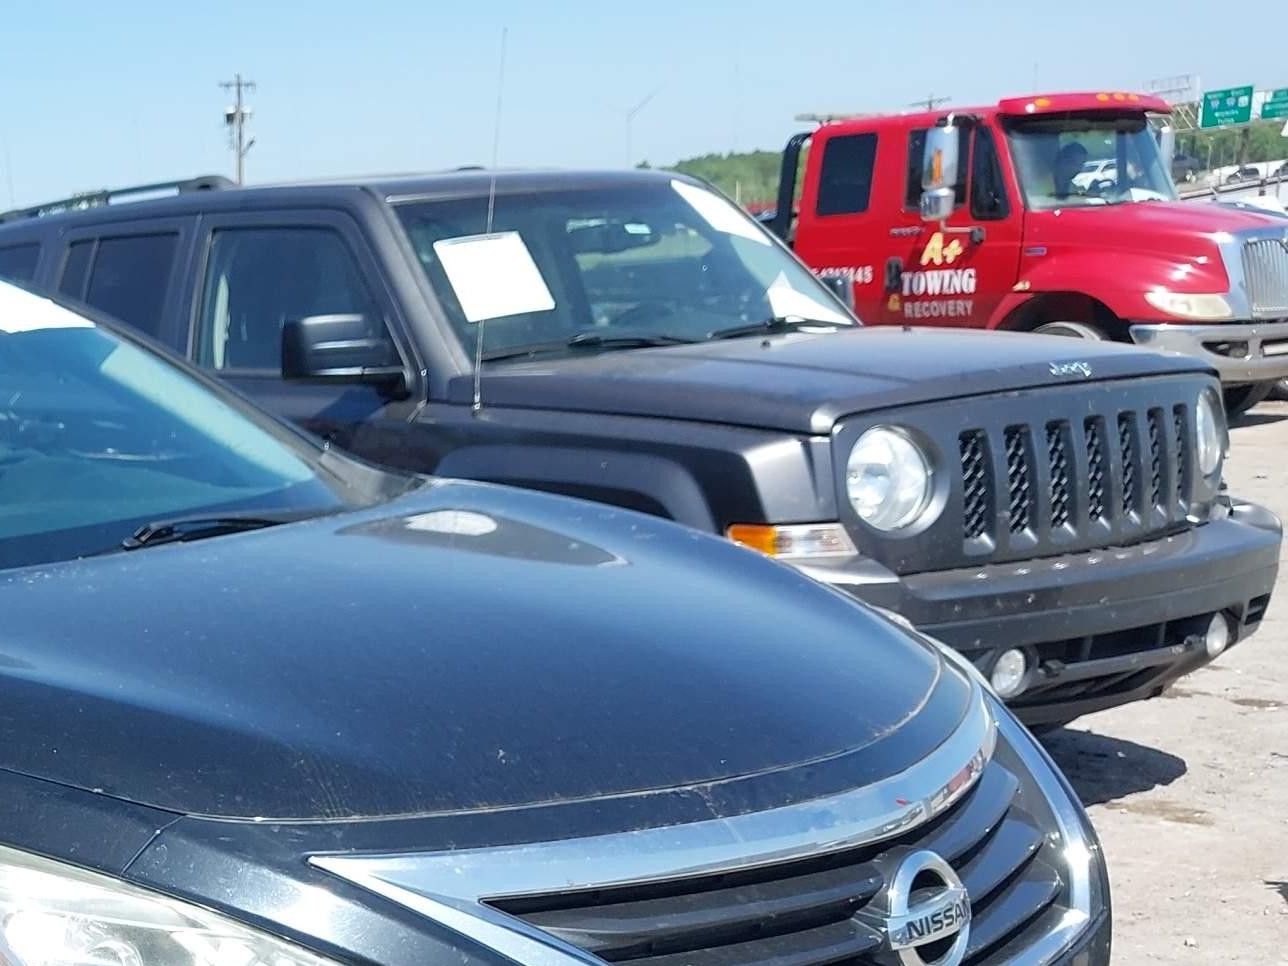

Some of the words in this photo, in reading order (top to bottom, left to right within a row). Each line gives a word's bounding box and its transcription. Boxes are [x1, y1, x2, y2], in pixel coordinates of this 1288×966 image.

[920, 232, 963, 266] A+
[900, 269, 976, 296] TOWING
[904, 300, 973, 318] RECOVERY
[906, 899, 969, 940] NISSAN
